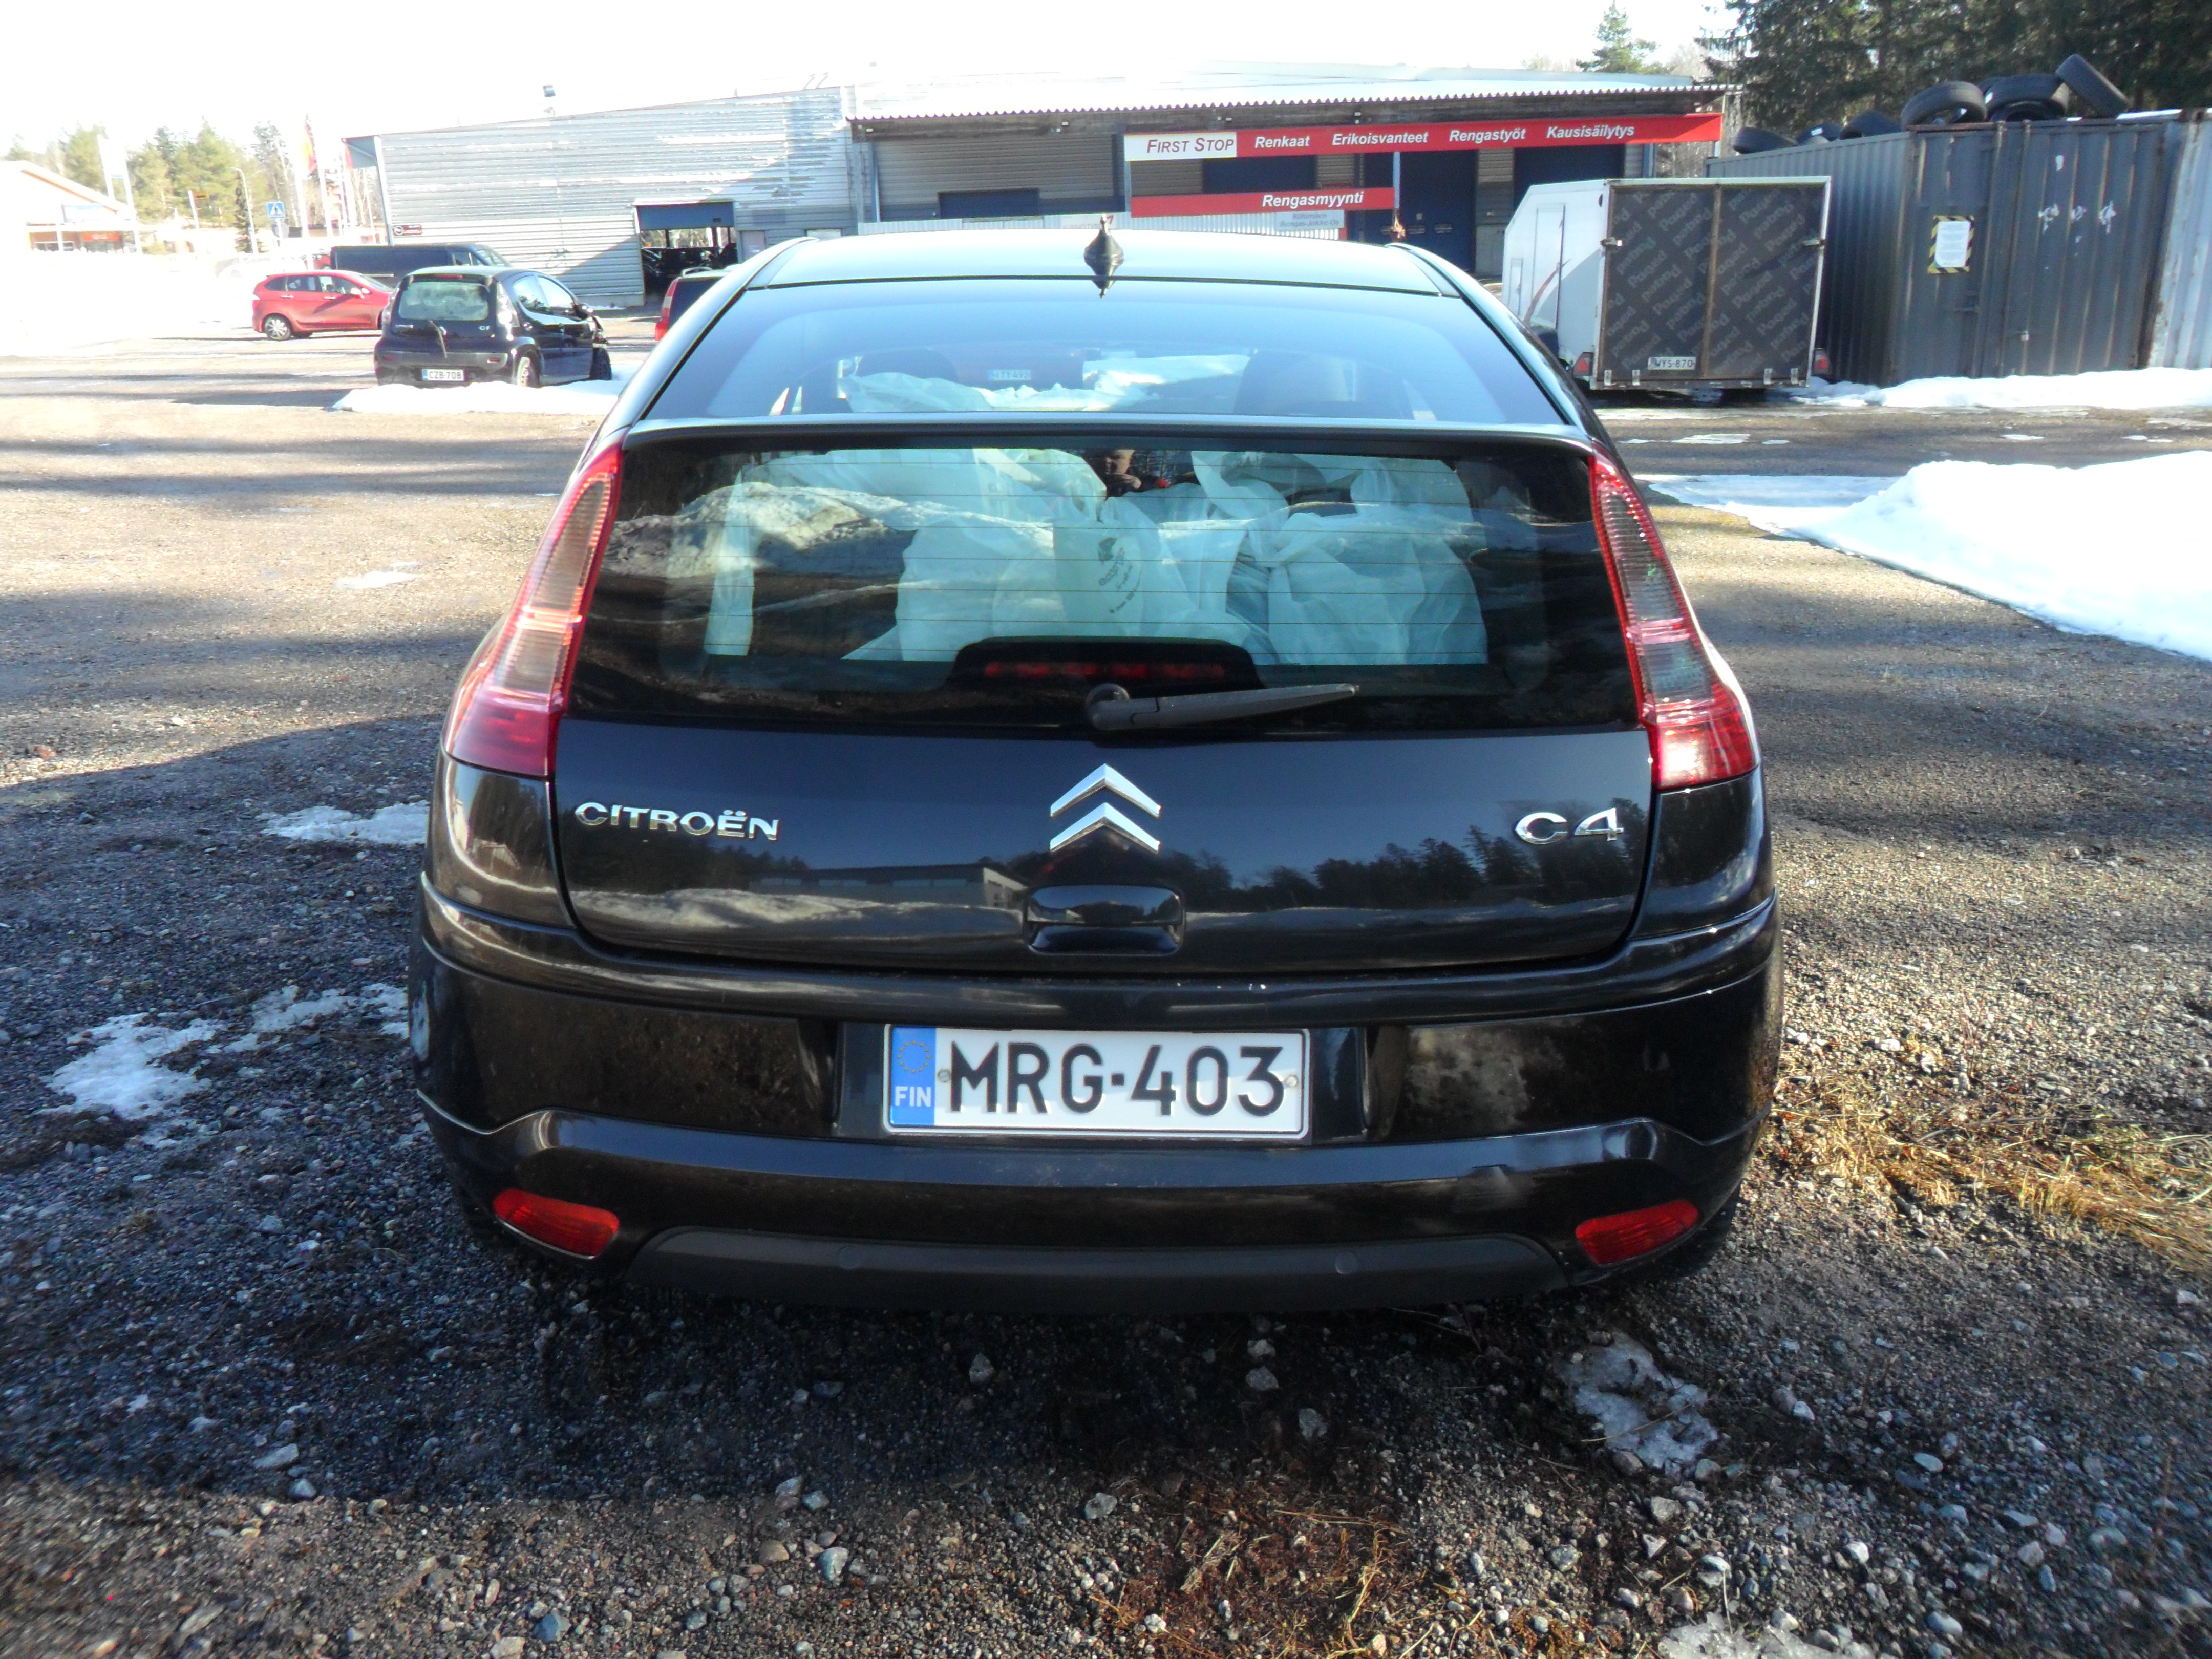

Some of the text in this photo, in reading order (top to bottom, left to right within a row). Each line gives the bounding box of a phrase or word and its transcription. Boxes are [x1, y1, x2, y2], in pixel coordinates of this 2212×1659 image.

[1332, 131, 1428, 146] Erikoisvanteet
[1449, 127, 1526, 143] Rengastyöt
[1546, 124, 1635, 140] Kausisäilytys
[1146, 137, 1235, 153] FIRST STOP
[1254, 136, 1310, 148] Renkaat
[1262, 190, 1364, 209] Rengasmyynti
[429, 371, 461, 379] CZB-708
[575, 802, 779, 840] CITROËN
[1515, 807, 1624, 845] C4
[895, 1040, 1284, 1117] FIN MRG-403
